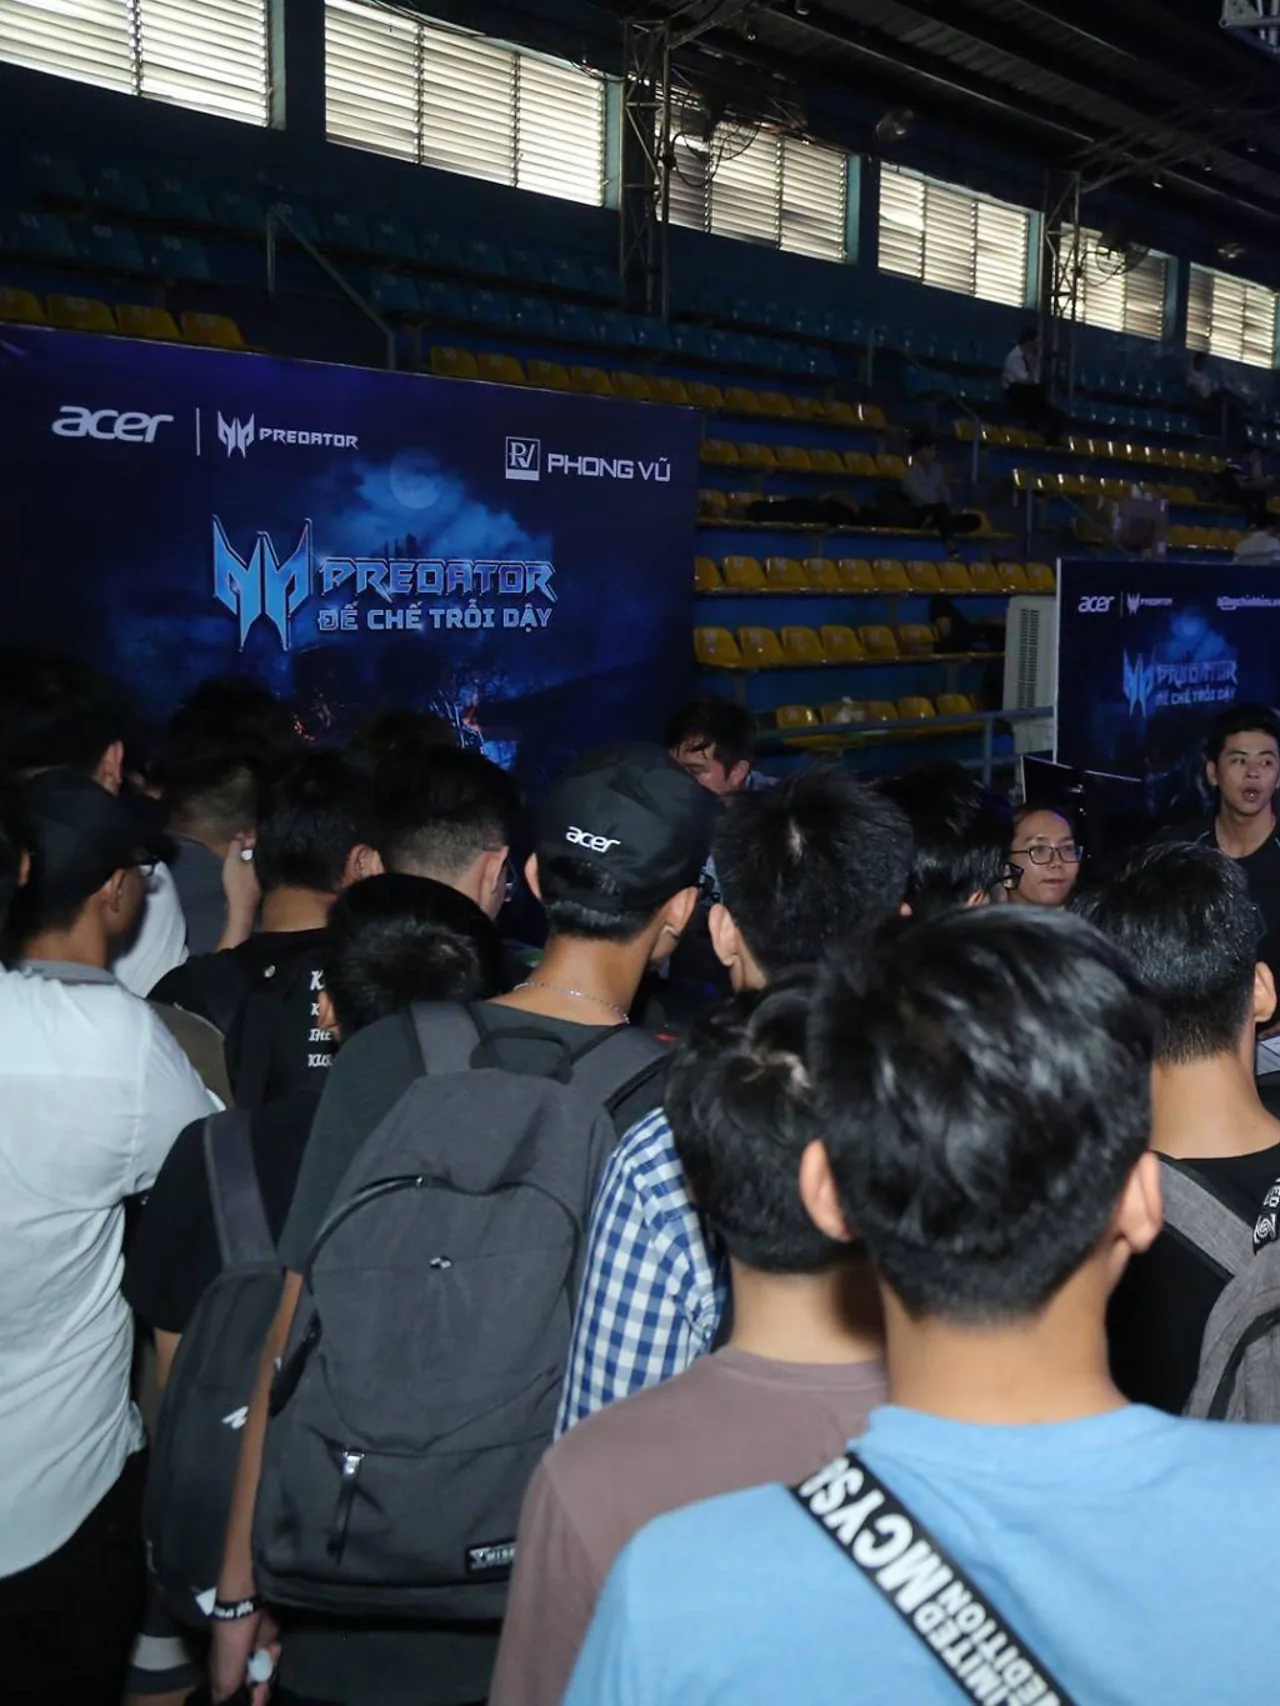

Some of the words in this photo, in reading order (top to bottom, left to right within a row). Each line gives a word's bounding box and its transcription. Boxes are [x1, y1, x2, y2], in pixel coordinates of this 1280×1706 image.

[51, 405, 174, 443] acer
[259, 427, 359, 450] PREDATOR
[547, 453, 634, 479] PHONG
[637, 457, 671, 482] VŨ
[318, 556, 557, 603] PREDATOR
[317, 600, 359, 631] ĐẾ
[366, 600, 422, 630] CHẾ
[502, 603, 552, 632] DẬY
[1078, 596, 1115, 613] acer
[566, 826, 620, 853] acer
